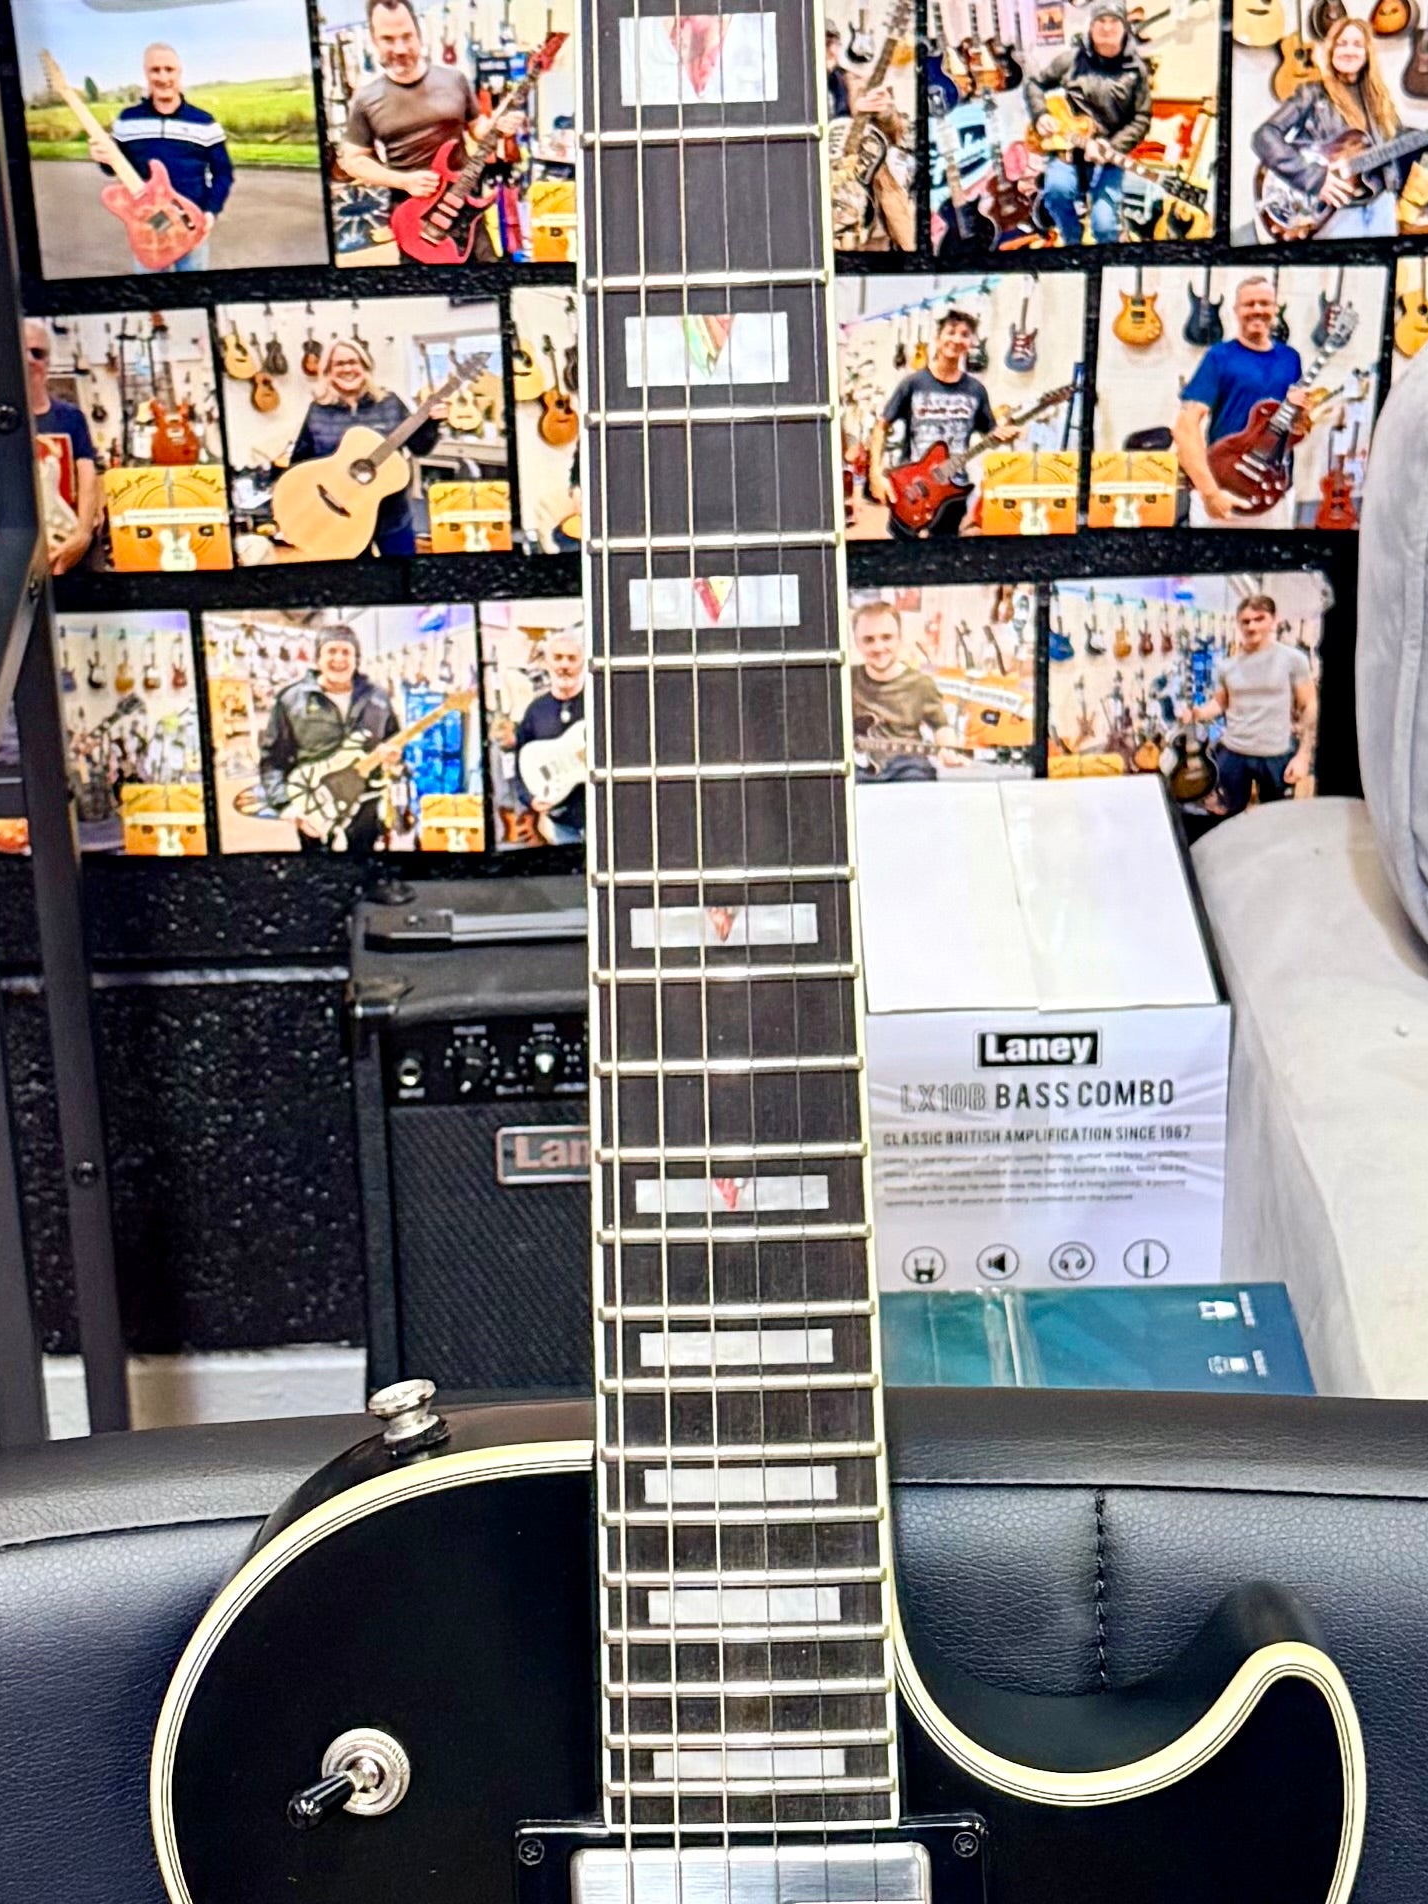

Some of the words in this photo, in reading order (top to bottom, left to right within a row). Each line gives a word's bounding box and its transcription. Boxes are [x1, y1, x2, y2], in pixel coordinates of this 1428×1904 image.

[984, 1033, 1094, 1066] Laney
[899, 1083, 987, 1113] LX10B
[994, 1081, 1070, 1111] BASS
[1077, 1078, 1175, 1108] COMBO
[883, 1131, 944, 1147] CLASSIC
[945, 1129, 1001, 1145] BRITISH
[1004, 1127, 1112, 1144] AMPLIFICATION
[1115, 1125, 1157, 1141] SINCE
